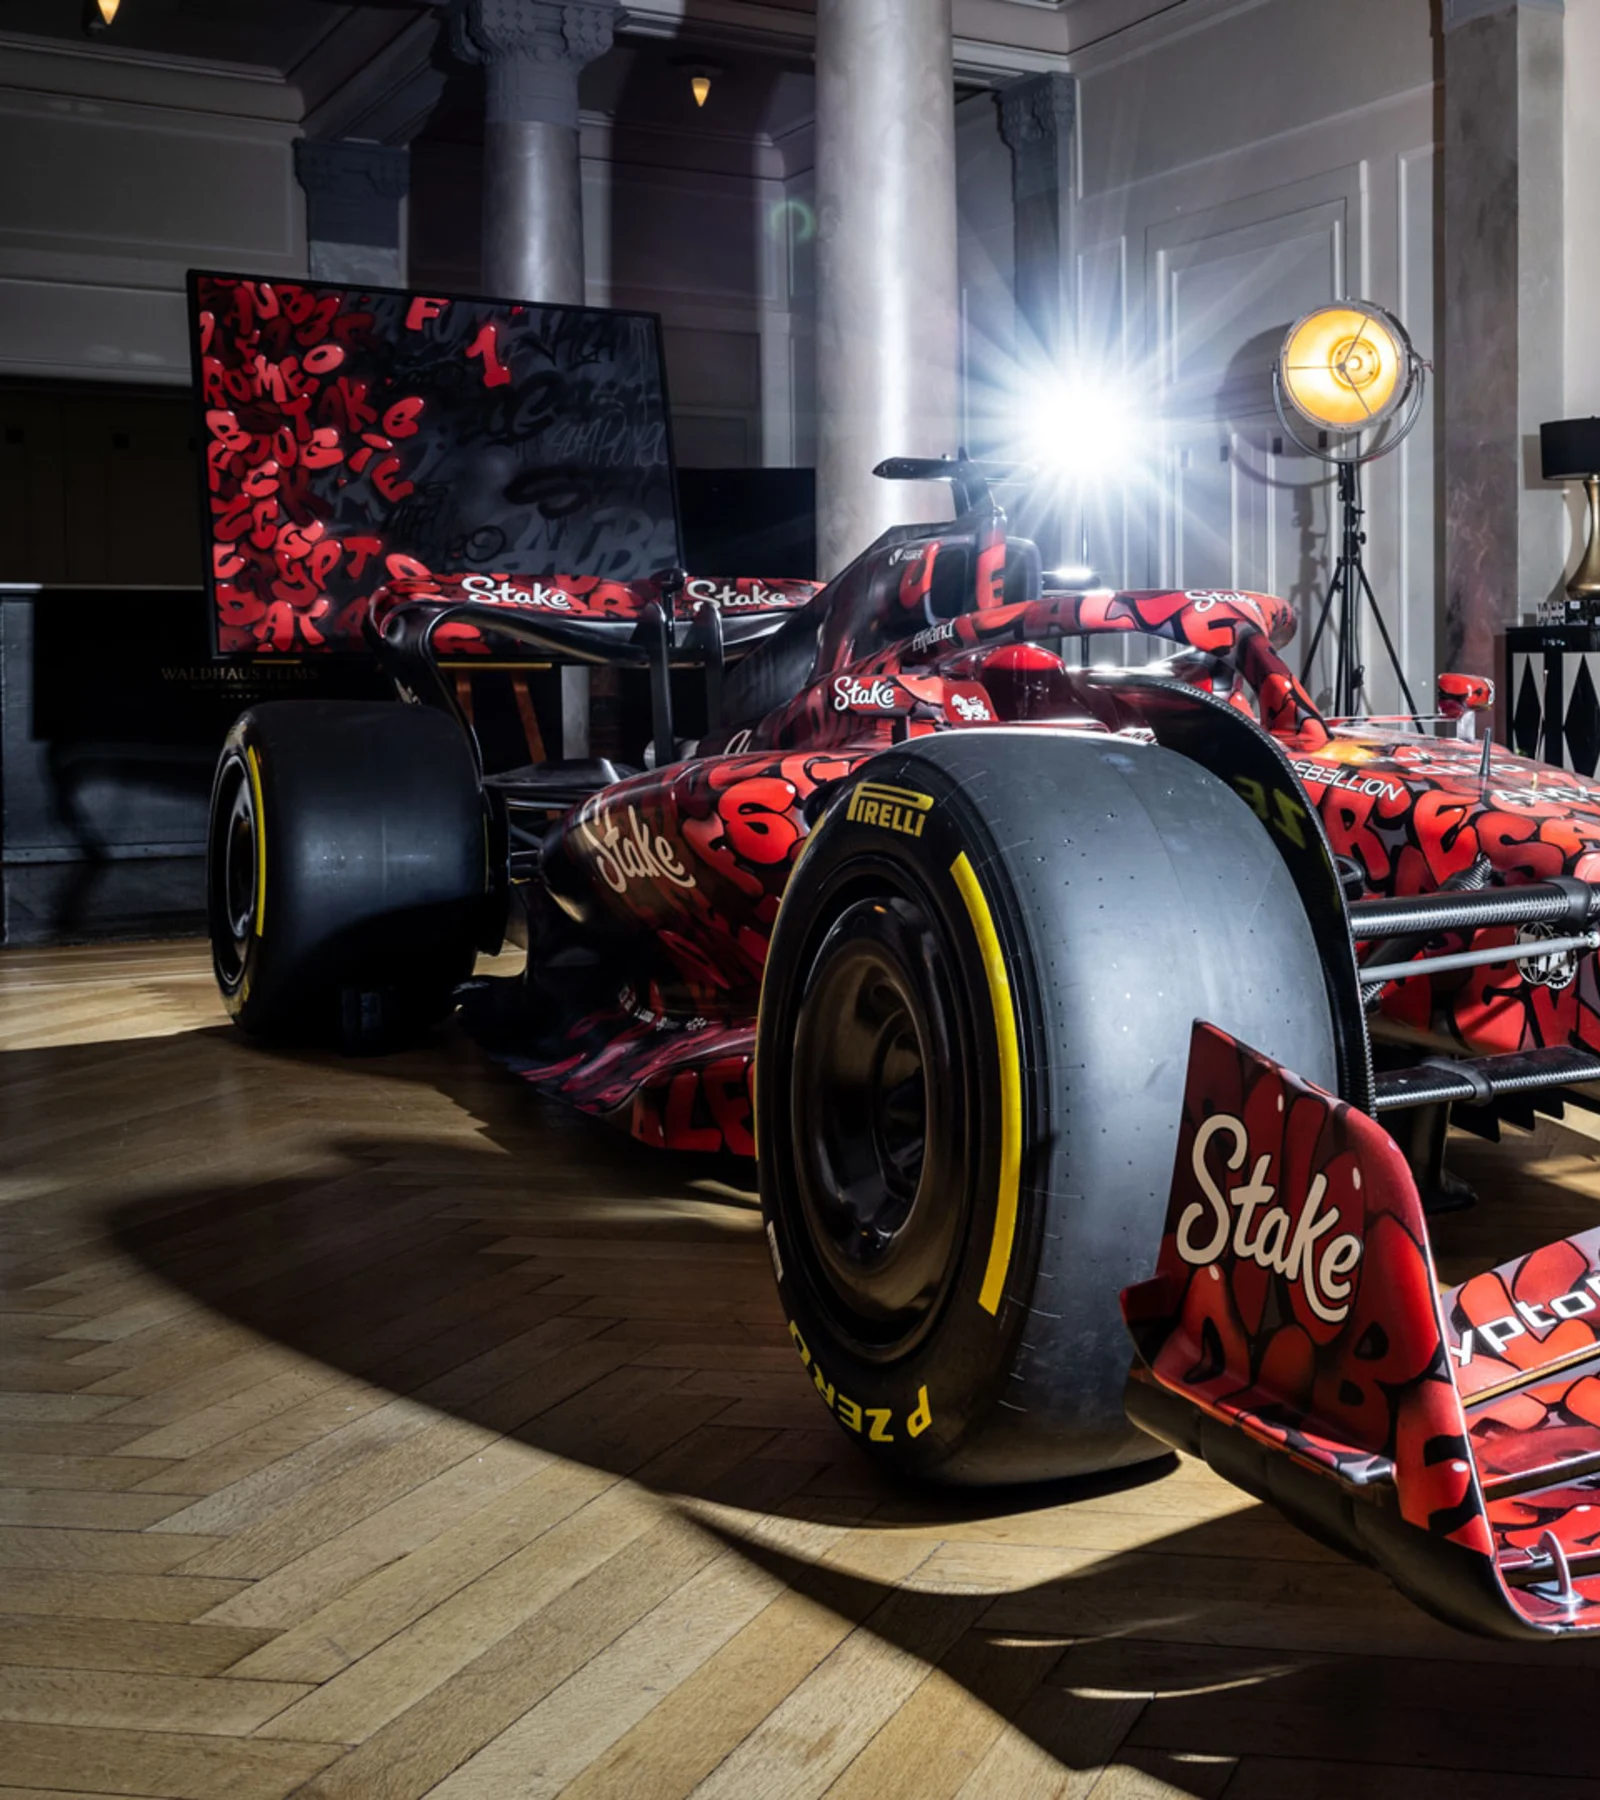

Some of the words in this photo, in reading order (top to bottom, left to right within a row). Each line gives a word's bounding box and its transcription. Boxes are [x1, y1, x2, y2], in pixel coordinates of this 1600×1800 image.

[461, 576, 572, 611] Stake
[687, 580, 788, 612] Stake
[160, 667, 263, 681] WALDHAUS
[833, 675, 896, 711] Stake
[846, 782, 934, 837] PIRELLI
[583, 792, 696, 893] Stake
[1176, 1113, 1366, 1322] Stake
[907, 1384, 933, 1438] P
